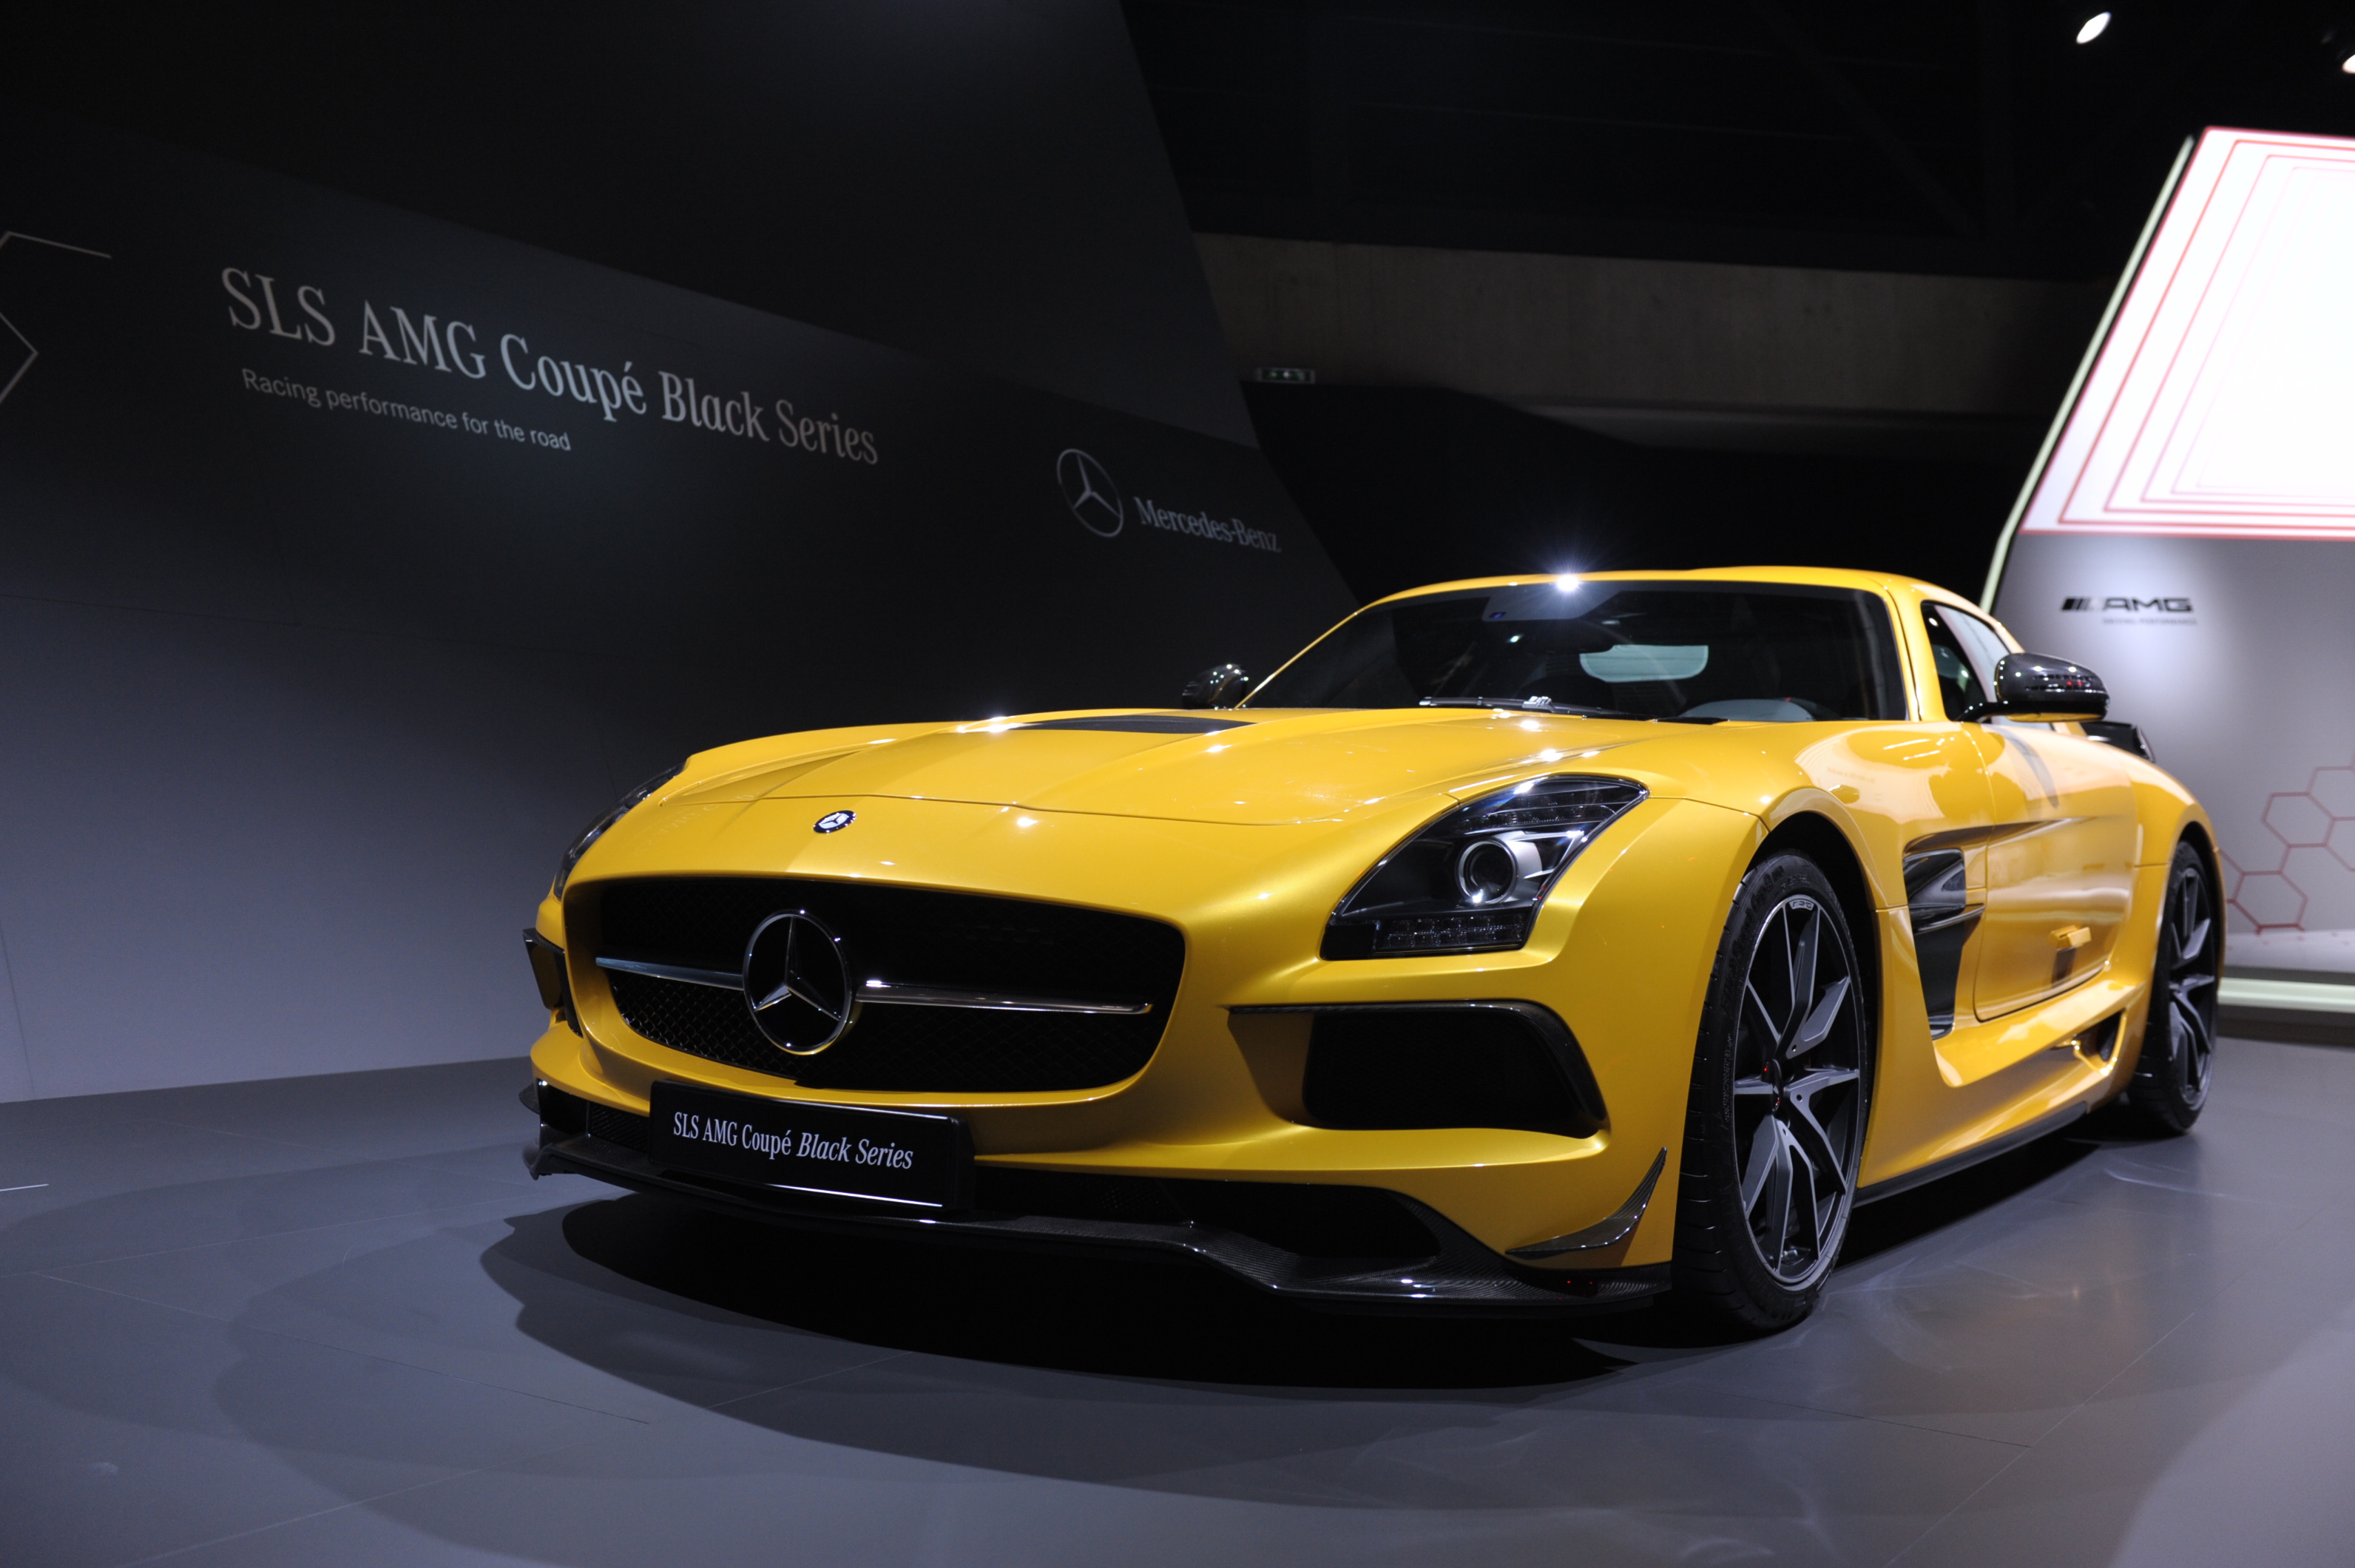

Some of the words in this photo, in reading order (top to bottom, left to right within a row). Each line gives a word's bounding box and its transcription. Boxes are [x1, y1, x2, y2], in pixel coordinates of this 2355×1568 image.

[221, 267, 336, 347] SLS
[359, 300, 487, 379] AMG
[499, 333, 647, 422] Coupé
[658, 371, 771, 442] Black
[775, 399, 879, 465] Series
[241, 368, 322, 408] Racing
[325, 390, 459, 430] performance
[462, 411, 489, 436] for
[493, 419, 526, 443] the
[529, 429, 572, 452] road
[1133, 496, 1282, 552] Mercedes-Benz
[2103, 597, 2194, 613] AMG
[673, 1111, 699, 1139] SLS
[702, 1118, 737, 1146] AMG
[742, 1124, 791, 1160] Coupé
[796, 1132, 851, 1163] Black
[855, 1138, 914, 1169] Series
